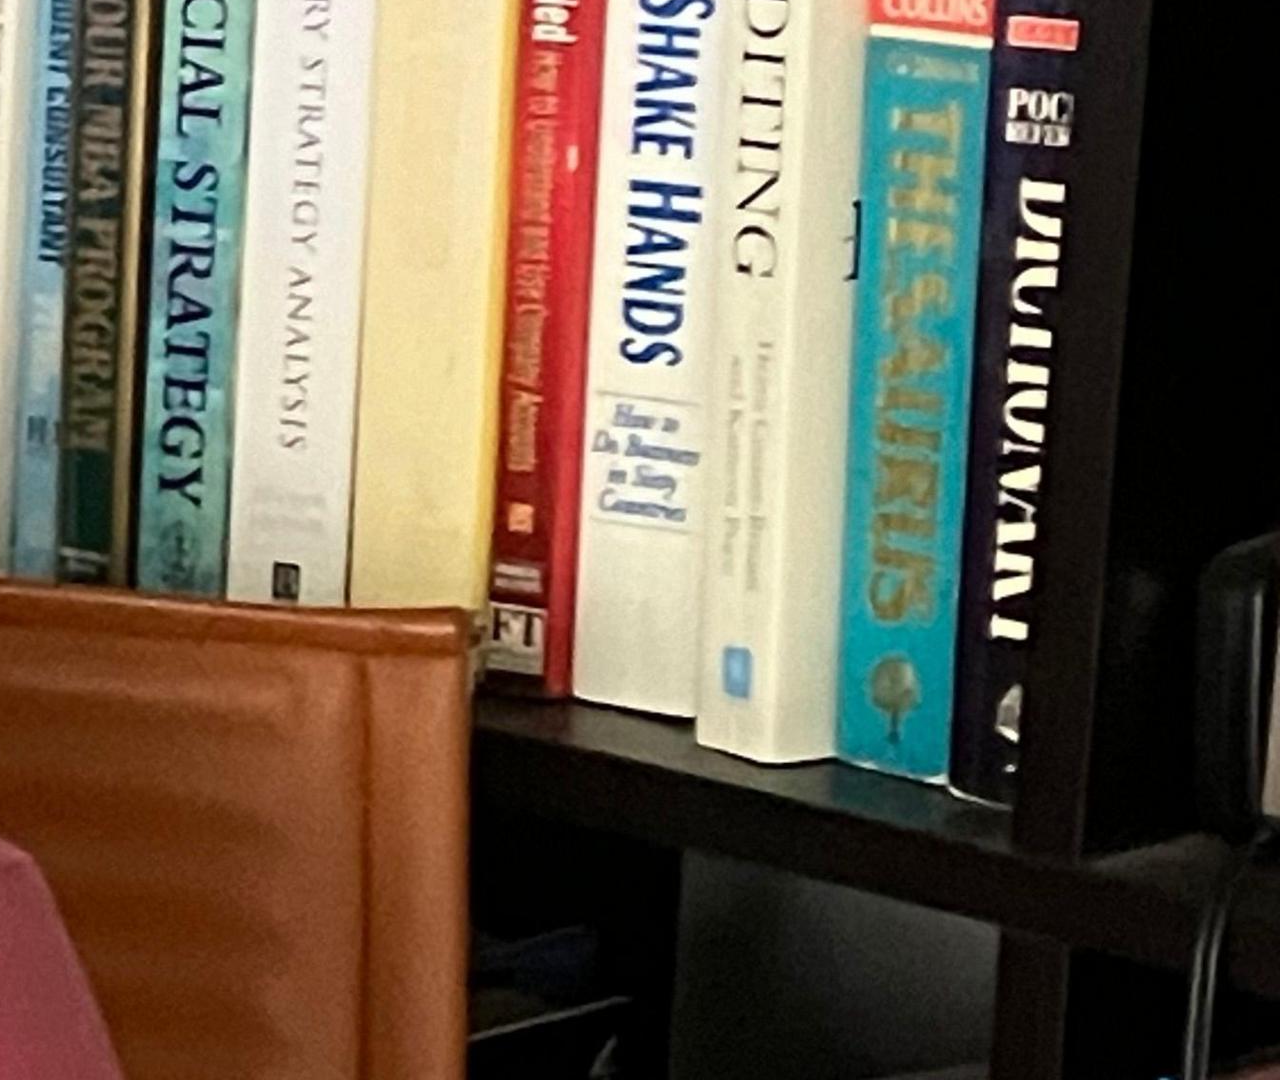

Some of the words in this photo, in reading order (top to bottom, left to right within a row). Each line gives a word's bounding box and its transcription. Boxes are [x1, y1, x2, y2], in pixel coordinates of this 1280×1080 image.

[37, 85, 72, 266] CONSULTANT
[290, 55, 328, 255] STRATEGY
[156, 160, 221, 510] STRATEGY
[277, 265, 314, 451] ANALYSIS
[619, 178, 704, 367] HANDS
[868, 99, 964, 628] THESAURUS
[492, 606, 540, 648] FT
